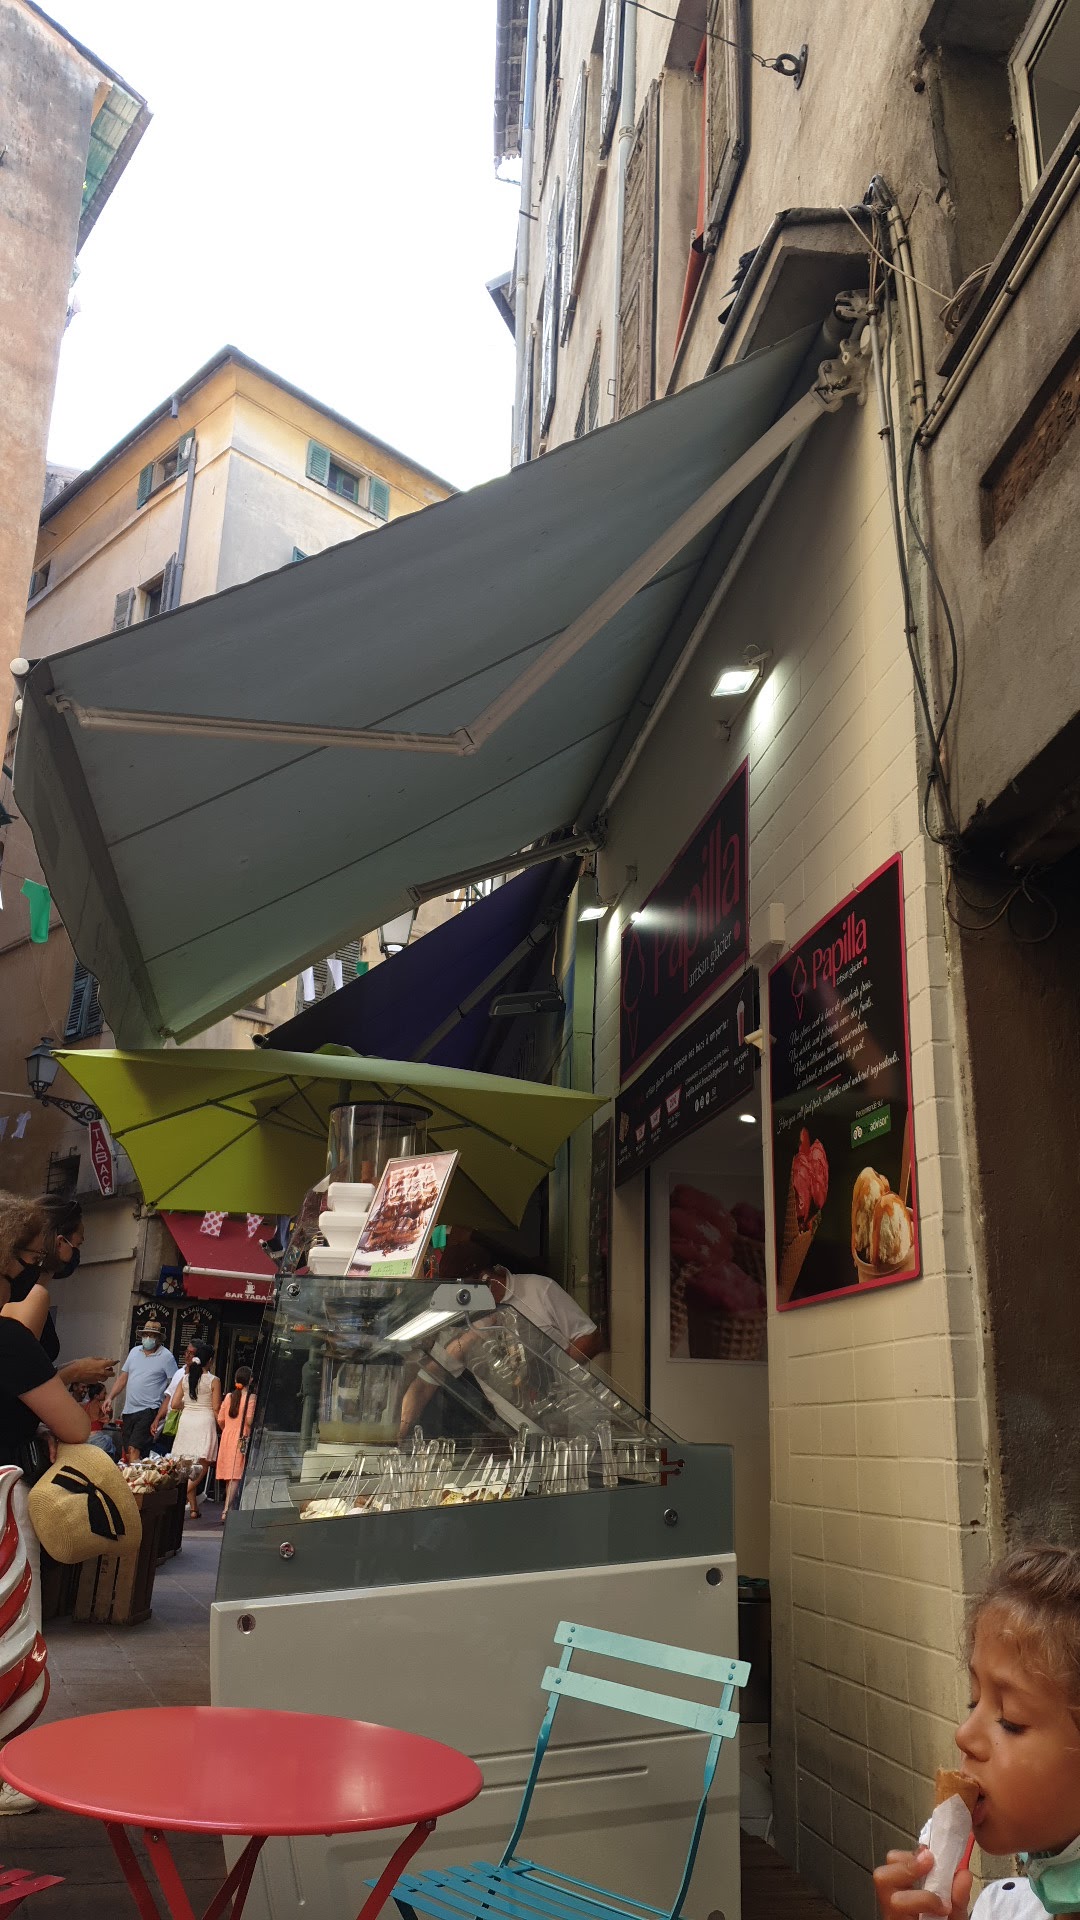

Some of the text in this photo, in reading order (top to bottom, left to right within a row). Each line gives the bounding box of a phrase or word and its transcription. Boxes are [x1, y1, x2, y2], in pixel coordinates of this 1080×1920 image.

[689, 930, 731, 988] artisan glacier
[812, 911, 867, 990] Papilla
[92, 1128, 110, 1187] TABAC
[136, 1302, 170, 1317] LE SAUVEUR
[180, 1305, 213, 1320] LE SAUVEUR
